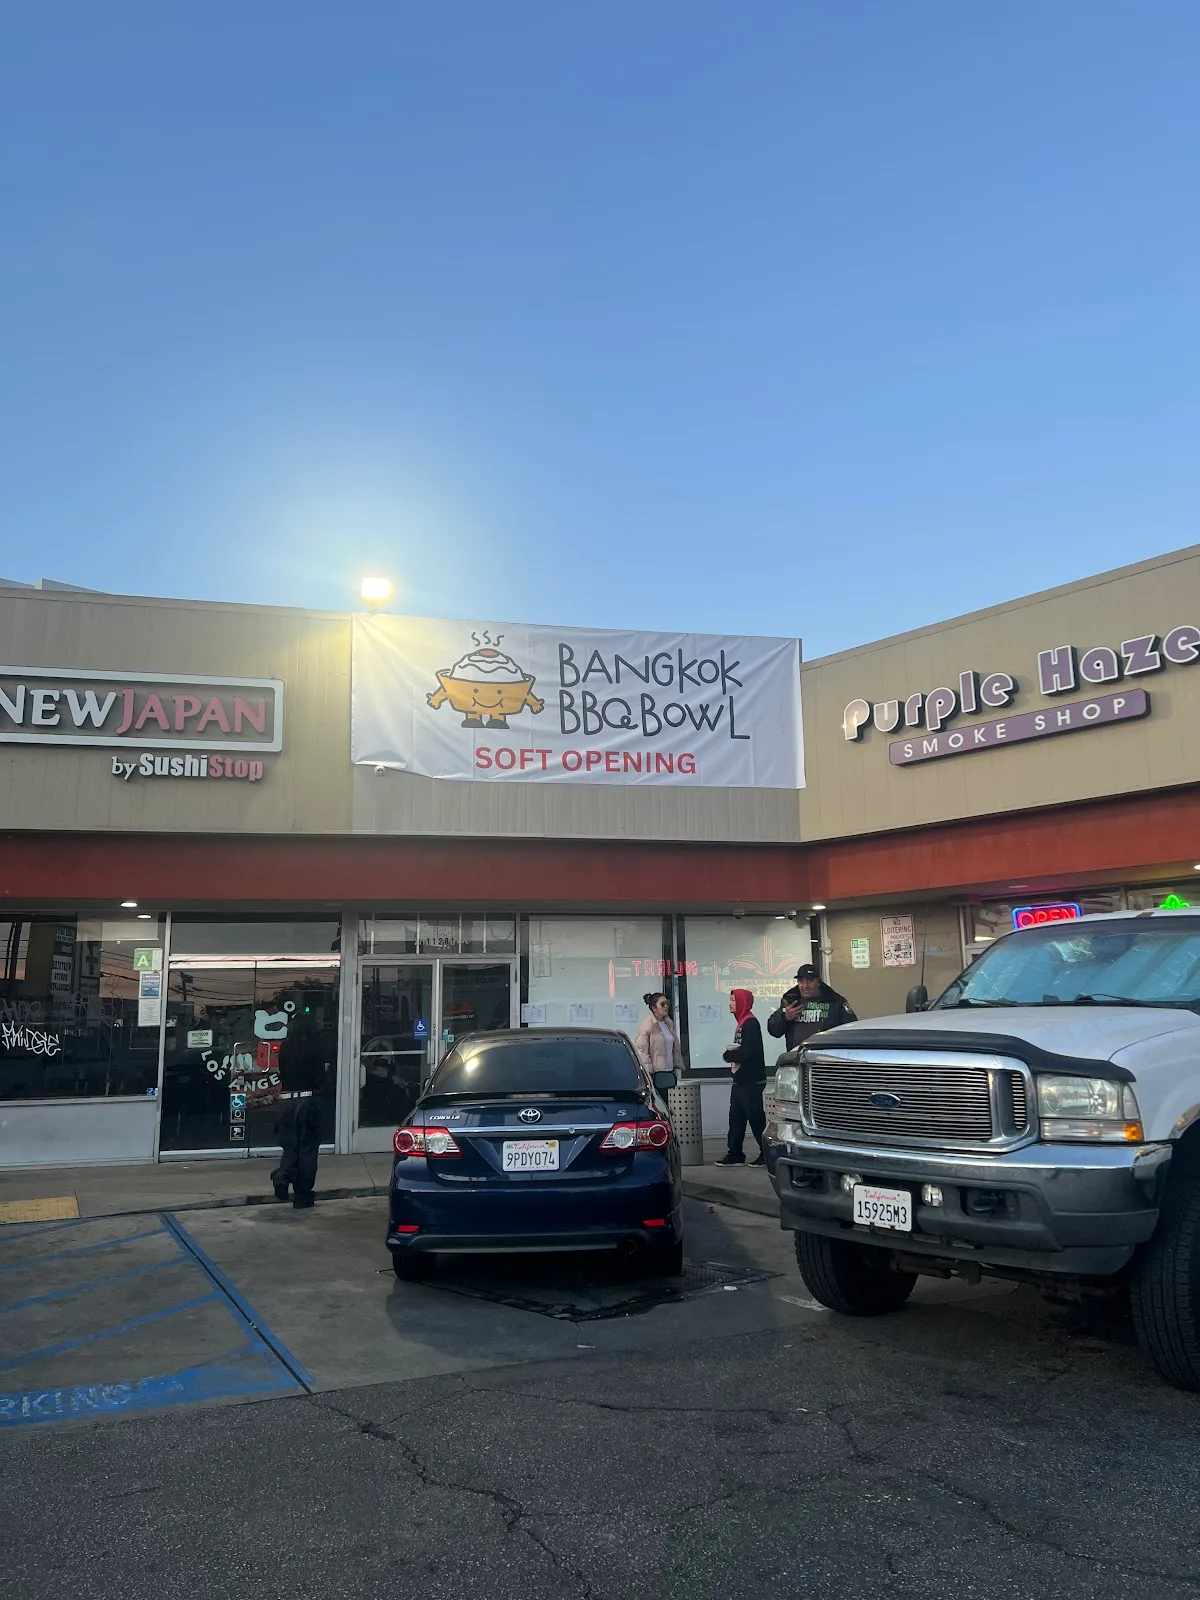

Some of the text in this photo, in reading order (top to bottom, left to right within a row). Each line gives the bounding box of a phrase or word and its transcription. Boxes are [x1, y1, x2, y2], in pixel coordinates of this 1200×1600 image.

[843, 625, 1200, 741] Purple Haze
[116, 688, 266, 734] JAPAN
[904, 698, 1127, 758] SMOKE SHOP
[111, 756, 137, 780] by
[475, 746, 697, 774] SOFT OPENING
[1018, 907, 1077, 928] OPEN
[884, 925, 912, 935] LOITERING
[137, 954, 149, 967] A
[201, 1050, 281, 1092] LOS ANGE
[617, 1109, 627, 1117] S
[514, 1142, 545, 1151] California
[507, 1152, 555, 1167] 9PDY074
[865, 1189, 899, 1202] California
[857, 1200, 907, 1225] 15925M3
